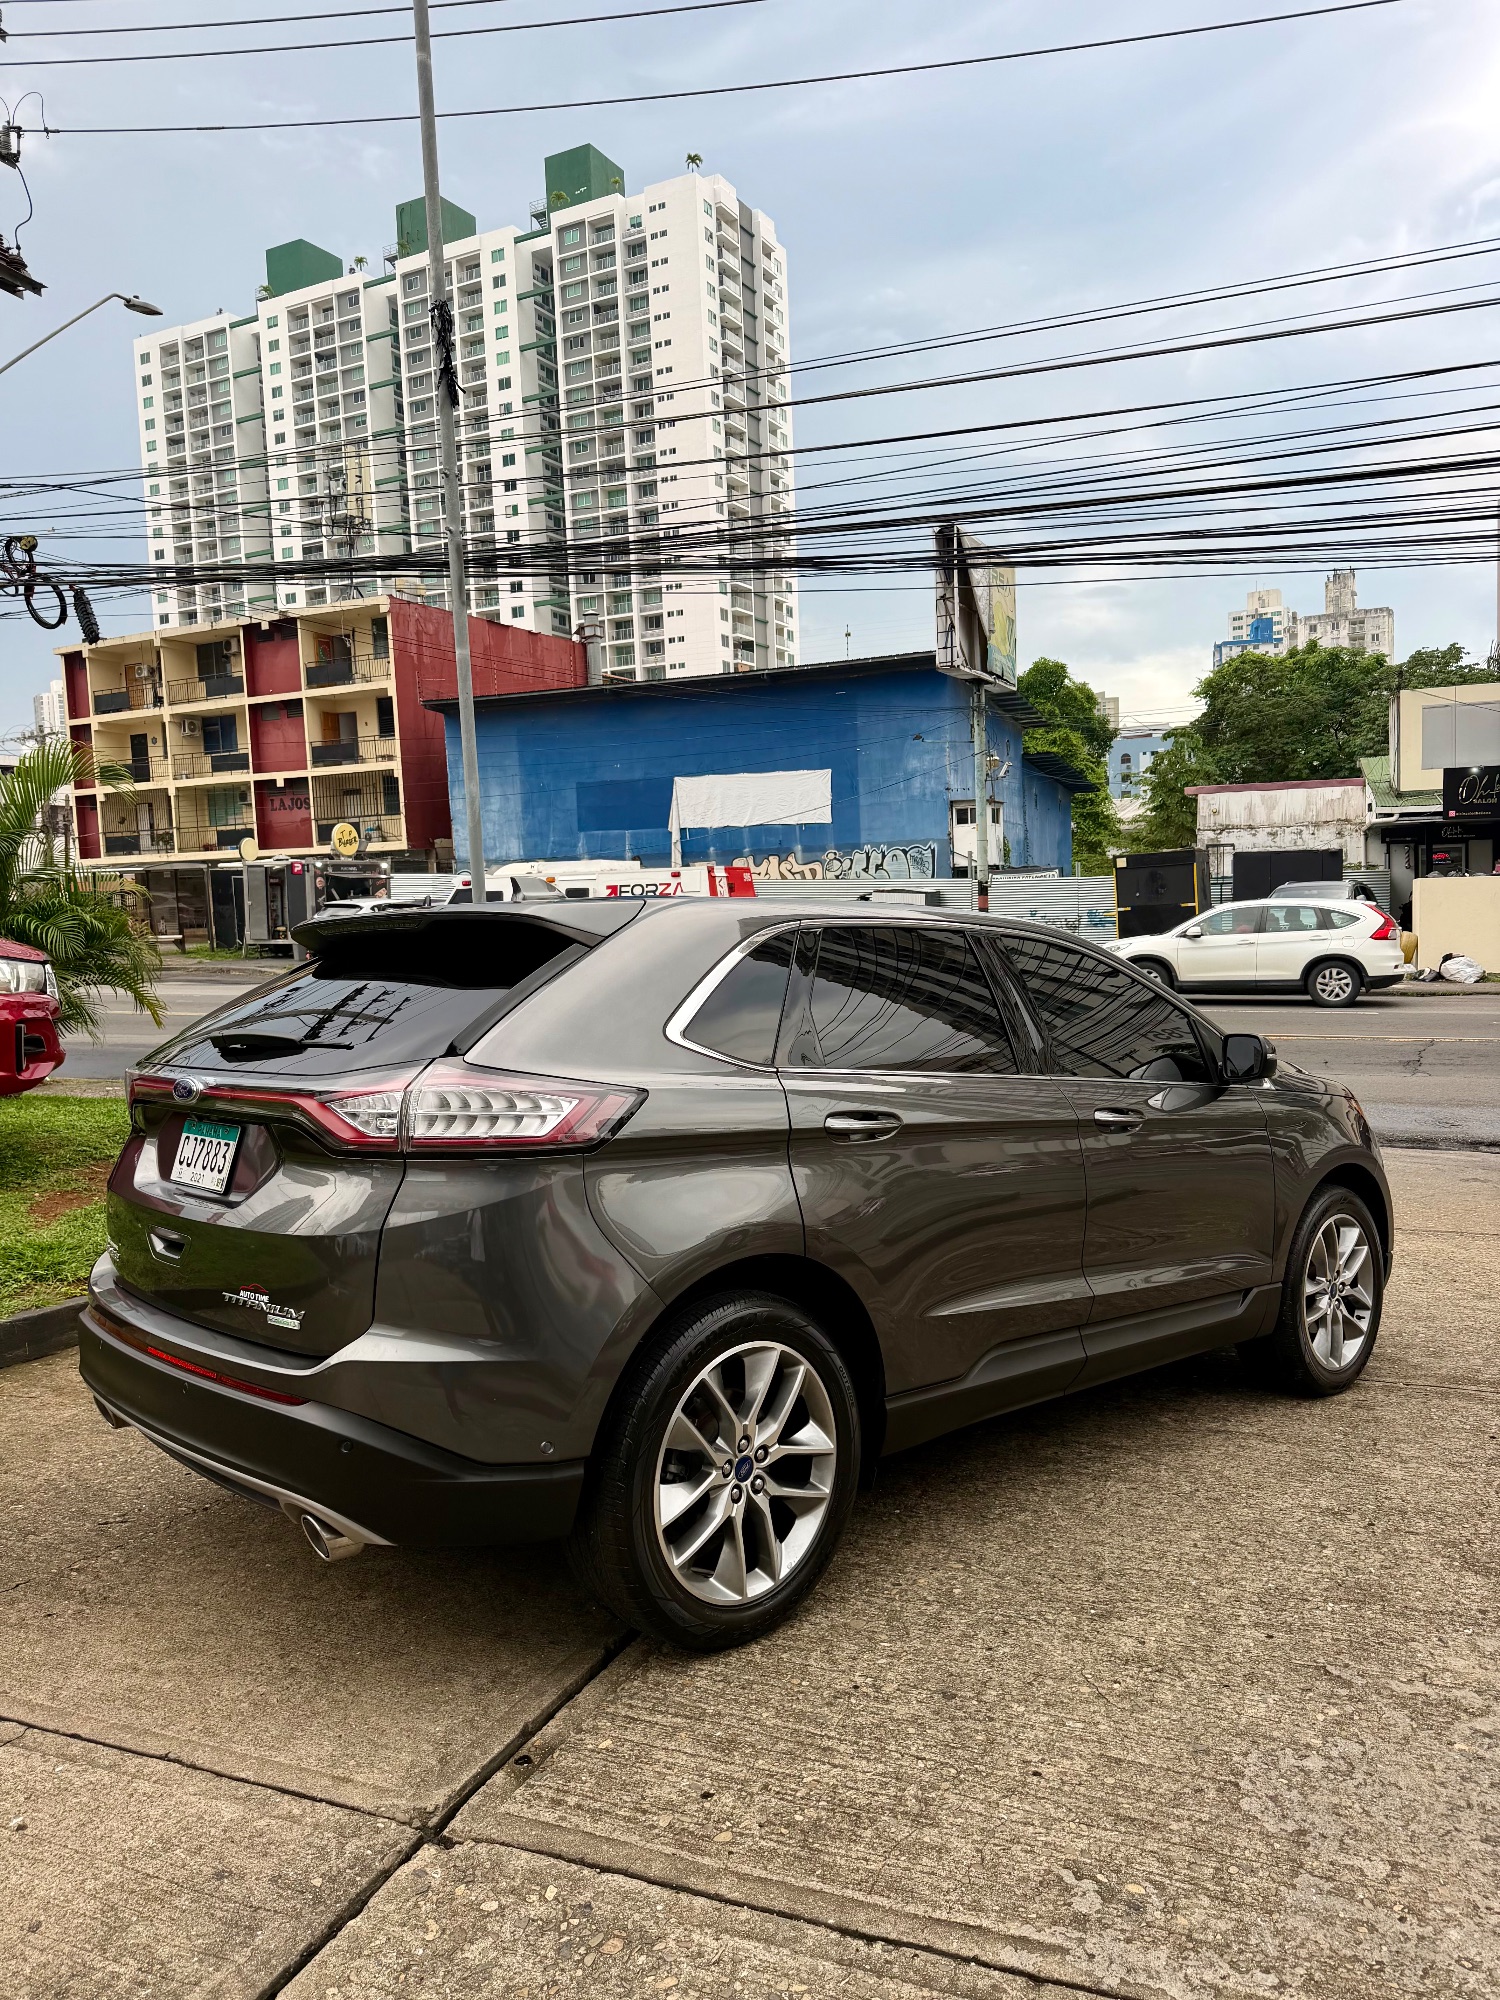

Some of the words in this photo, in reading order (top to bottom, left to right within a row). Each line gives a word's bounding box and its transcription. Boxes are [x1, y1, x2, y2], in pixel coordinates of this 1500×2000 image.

[270, 797, 311, 811] LAJOS
[618, 882, 684, 897] FORZA
[179, 1135, 230, 1175] CJ7883
[190, 1171, 205, 1184] 2021
[240, 1289, 255, 1300] AUTO
[255, 1294, 270, 1303] TIME
[222, 1291, 306, 1320] TITANIUM
[838, 1365, 856, 1409] OUTSIDE
